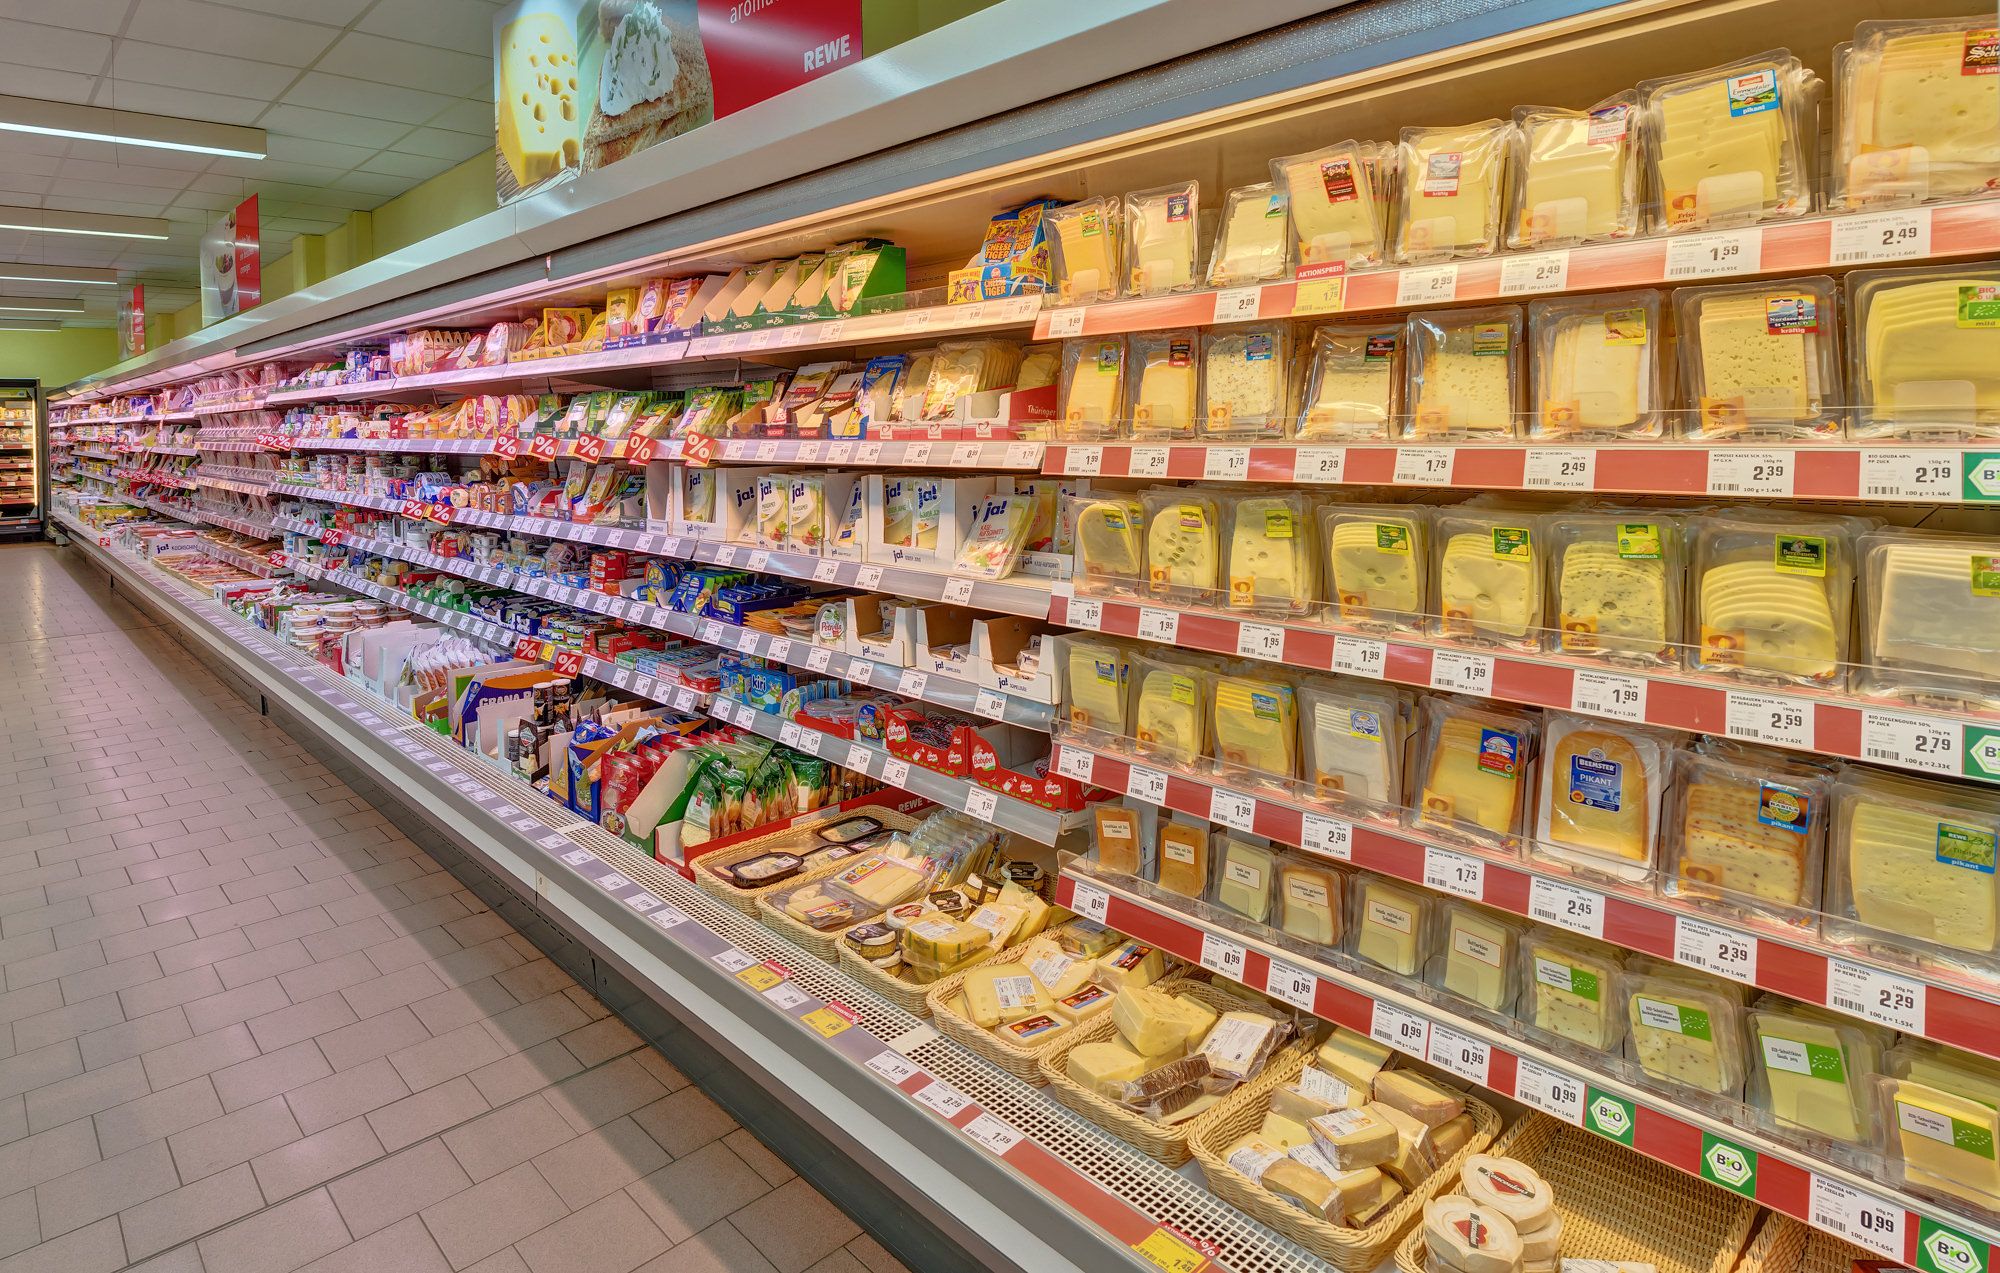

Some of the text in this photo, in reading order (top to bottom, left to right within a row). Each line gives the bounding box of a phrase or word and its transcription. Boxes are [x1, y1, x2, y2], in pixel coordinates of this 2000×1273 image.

[804, 34, 850, 72] REWE
[1882, 227, 1917, 246] 2.49
[987, 242, 1012, 251] CHEESE
[1710, 245, 1739, 262] 1.59
[985, 250, 1010, 259] TIGER
[1298, 265, 1344, 279] AKTIONSPREIS
[1535, 265, 1561, 281] 2.49
[985, 285, 1006, 296] TIGER
[1431, 276, 1453, 291] 2.99
[1238, 298, 1255, 311] 2.09
[1068, 317, 1081, 327] 1.69
[1028, 404, 1056, 417] Thüringer
[1085, 455, 1099, 466] 1.99
[1150, 457, 1165, 468] 2.59
[1228, 457, 1244, 468] 1.79
[1320, 460, 1339, 473] 2.39
[1425, 459, 1447, 473] 1.79
[1561, 462, 1586, 476] 2.49
[1753, 466, 1783, 480] 2.39
[1915, 467, 1951, 483] 2.19
[736, 486, 755, 508] ja!
[760, 481, 772, 502] ja!
[792, 483, 804, 504] ja!
[885, 482, 901, 505] ja!
[918, 485, 937, 509] ja!
[983, 501, 1007, 523] ja!
[157, 544, 169, 553] ja!
[893, 550, 903, 563] ja!
[1021, 556, 1033, 569] ja!
[1085, 609, 1099, 620] 1.95
[1159, 620, 1174, 632] 1.95
[1262, 637, 1279, 648] 1.95
[1361, 650, 1379, 662] 1.99
[935, 661, 944, 671] ja!
[1464, 667, 1486, 680] 1.99
[752, 675, 766, 692] kiri
[998, 678, 1008, 689] ja!
[1613, 689, 1638, 704] 1.99
[1771, 713, 1802, 730] 2.59
[888, 728, 906, 738] Babybel
[1915, 735, 1951, 754] 2.79
[973, 756, 993, 765] Babybel
[1579, 759, 1615, 771] BEEMSTER
[1149, 779, 1164, 793] 1.99
[1580, 774, 1612, 786] PIKANT
[898, 798, 923, 812] REWE
[1234, 804, 1251, 818] 1.99
[1771, 820, 1794, 831] pikant
[1327, 829, 1347, 844] 2.39
[1951, 859, 1979, 870] pikant
[1455, 867, 1477, 882] 1.73
[1091, 898, 1105, 910] 0.99
[1567, 899, 1592, 916] 2.45
[1224, 952, 1240, 966] 0.99
[1719, 944, 1748, 962] 2.39
[1835, 963, 1857, 972] TILSITER
[1292, 980, 1311, 994] 0.99
[1880, 990, 1914, 1010] 2.29
[1895, 1019, 1913, 1028] 1.53€
[1401, 1023, 1421, 1039] 0.99
[1462, 1049, 1484, 1065] 0.99
[891, 1064, 909, 1076] 1.39
[1552, 1085, 1576, 1103] 0.99
[993, 1131, 1013, 1145] 1.39
[1860, 1210, 1894, 1233] 0.99
[1850, 1231, 1863, 1240] 100
[1875, 1241, 1894, 1253] 1.65€
